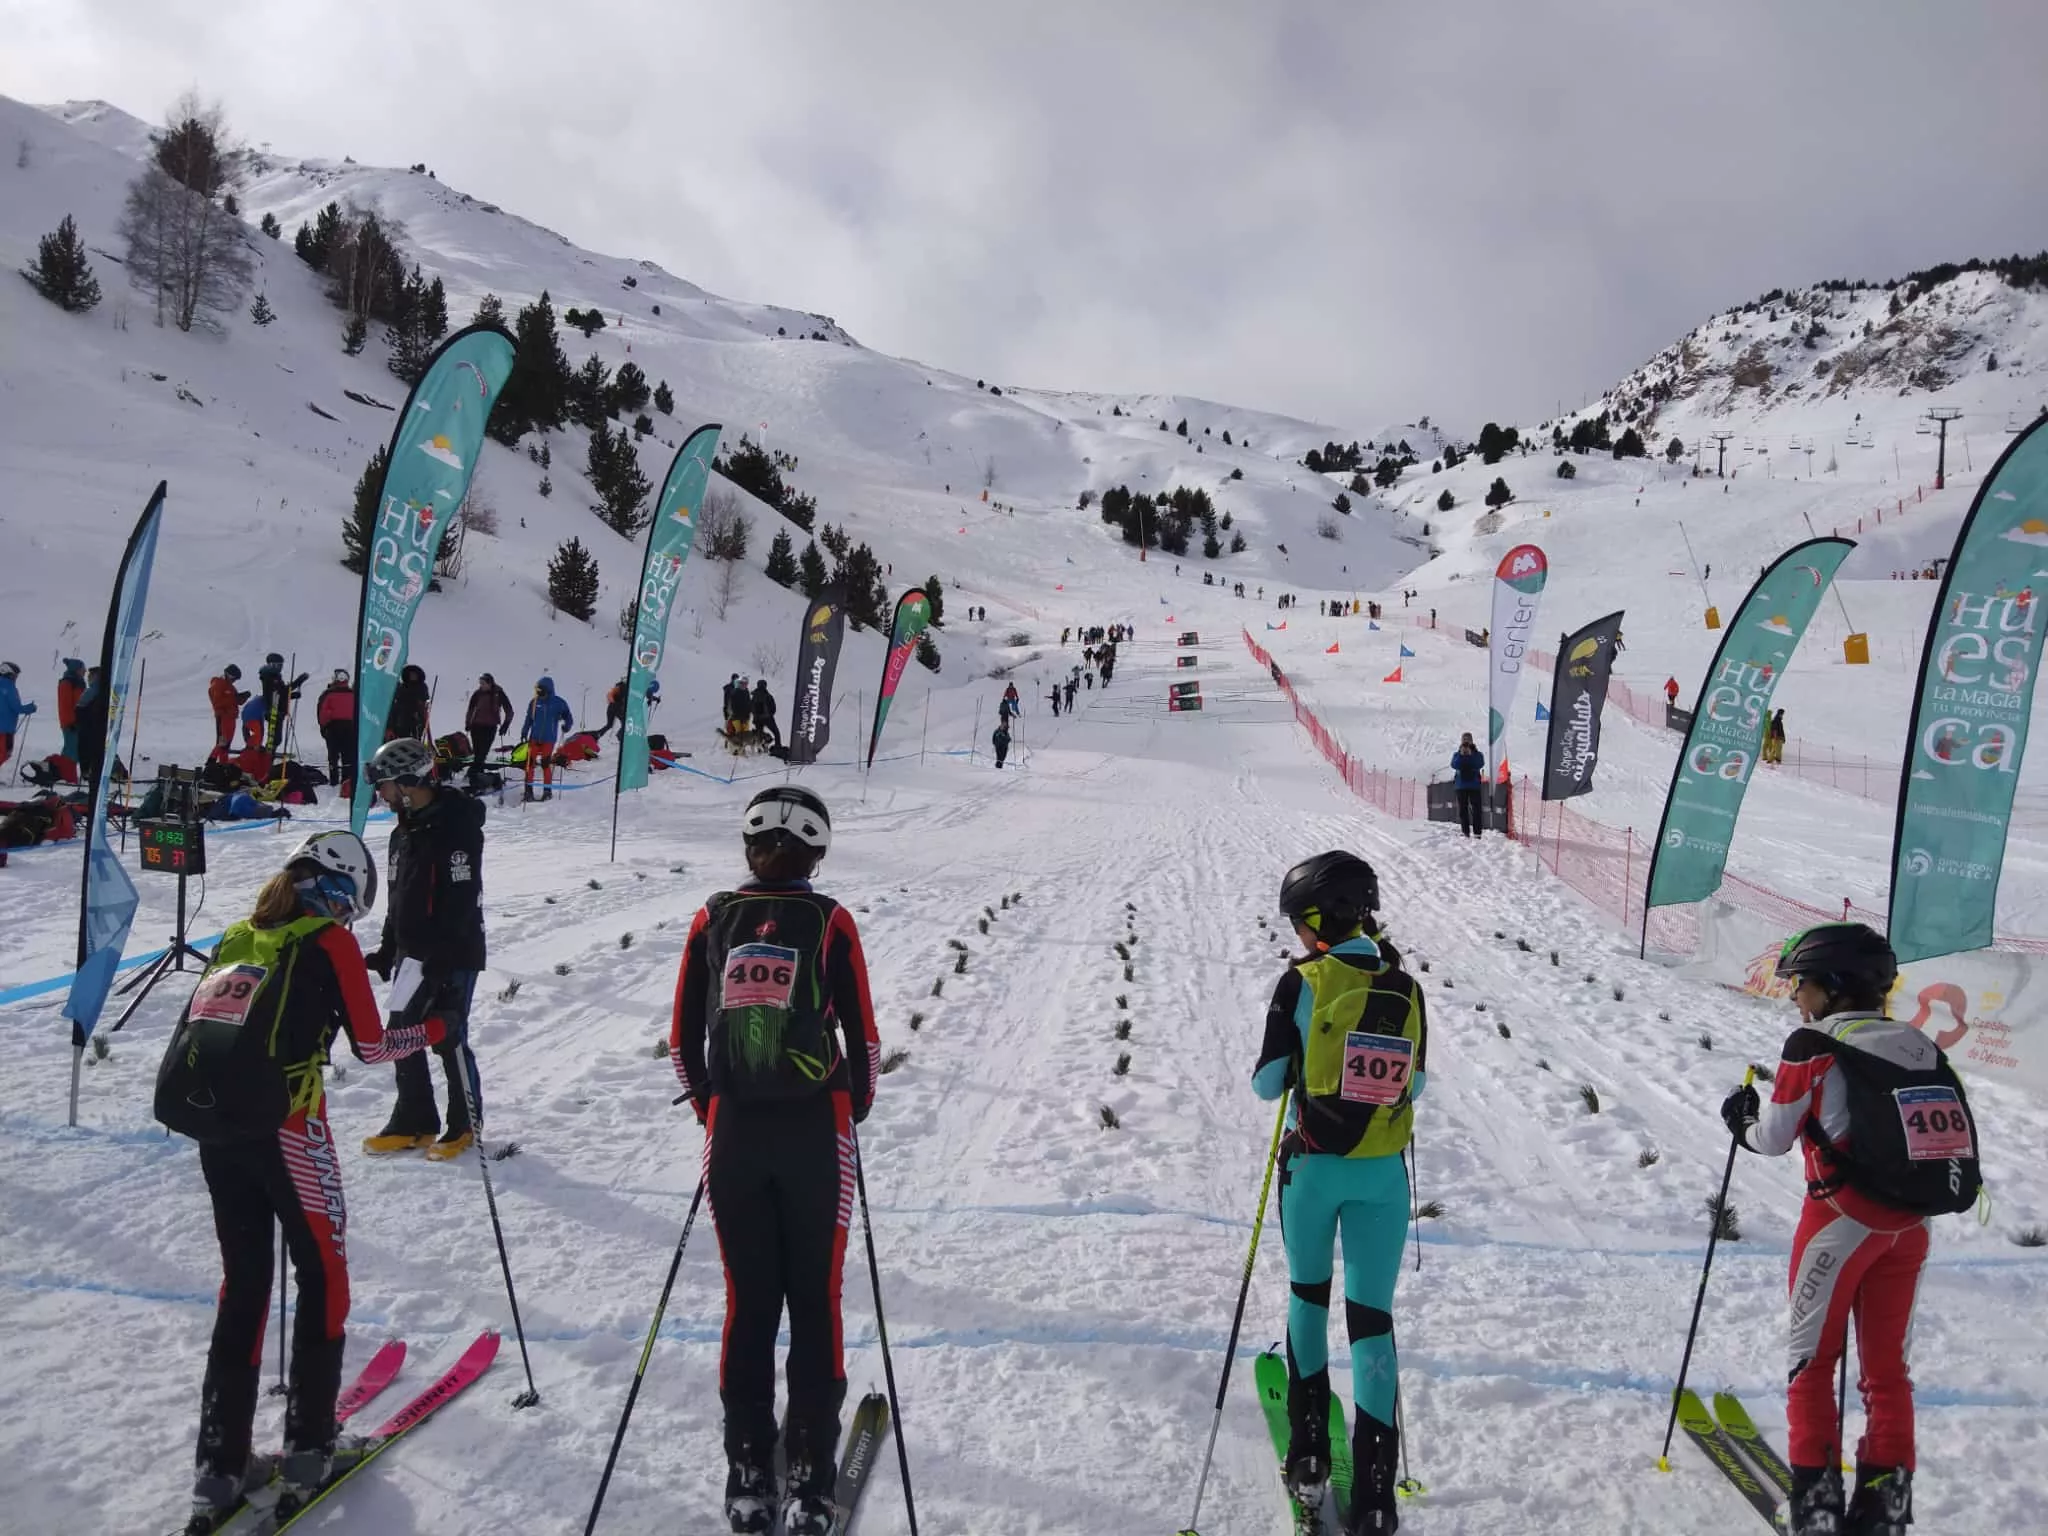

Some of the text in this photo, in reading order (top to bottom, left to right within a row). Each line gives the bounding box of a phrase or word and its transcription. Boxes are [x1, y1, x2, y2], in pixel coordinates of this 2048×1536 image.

[889, 622, 915, 681] cerler
[1501, 597, 1535, 675] cerler
[808, 656, 827, 743] aigualluts
[1570, 690, 1596, 782] aigualluts
[728, 964, 792, 986] 406
[1348, 1055, 1408, 1082] 407
[1907, 1110, 1966, 1134] 408
[848, 1430, 873, 1479] DYNAFIT
